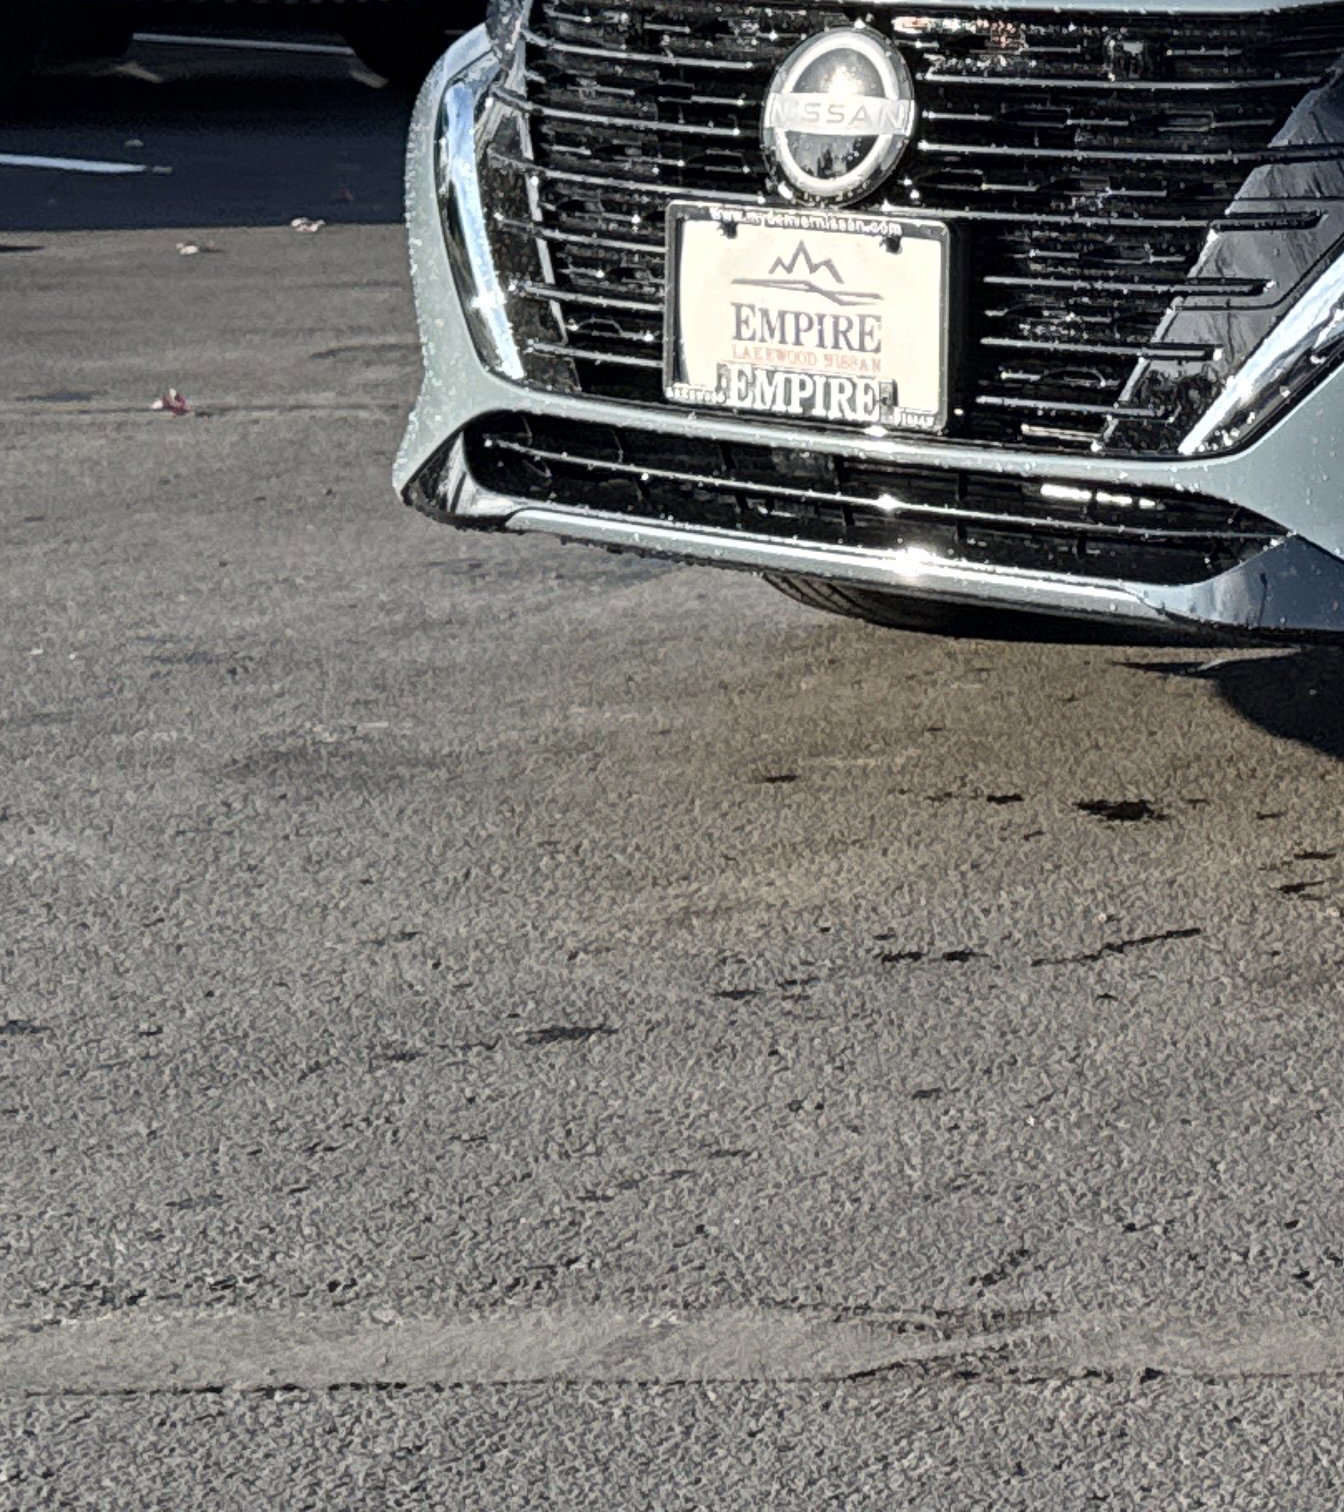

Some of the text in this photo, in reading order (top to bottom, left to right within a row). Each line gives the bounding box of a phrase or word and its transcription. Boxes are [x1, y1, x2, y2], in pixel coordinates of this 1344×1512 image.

[770, 96, 906, 131] NISSAN
[731, 302, 882, 354] EMPIRE
[728, 362, 881, 422] EMPIRE
